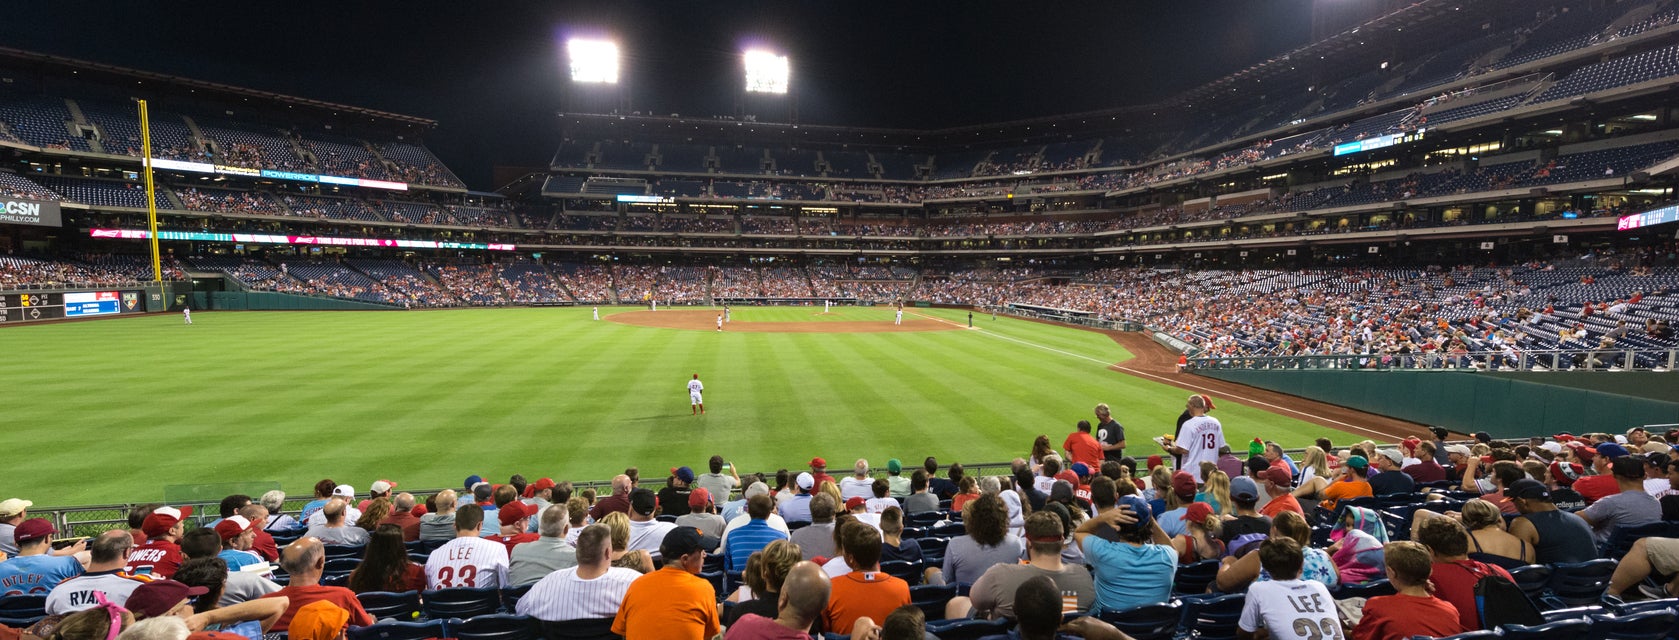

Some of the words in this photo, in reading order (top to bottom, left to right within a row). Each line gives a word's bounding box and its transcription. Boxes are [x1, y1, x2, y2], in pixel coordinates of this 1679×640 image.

[6, 201, 40, 216] CSN
[0, 214, 40, 223] PHILLY.COM
[1202, 433, 1215, 450] 13
[128, 548, 167, 562] OWERS
[449, 546, 474, 560] LEE
[2, 573, 44, 588] UTLEY
[436, 564, 477, 590] 33
[70, 589, 107, 607] RYA
[1287, 592, 1325, 613] LEE
